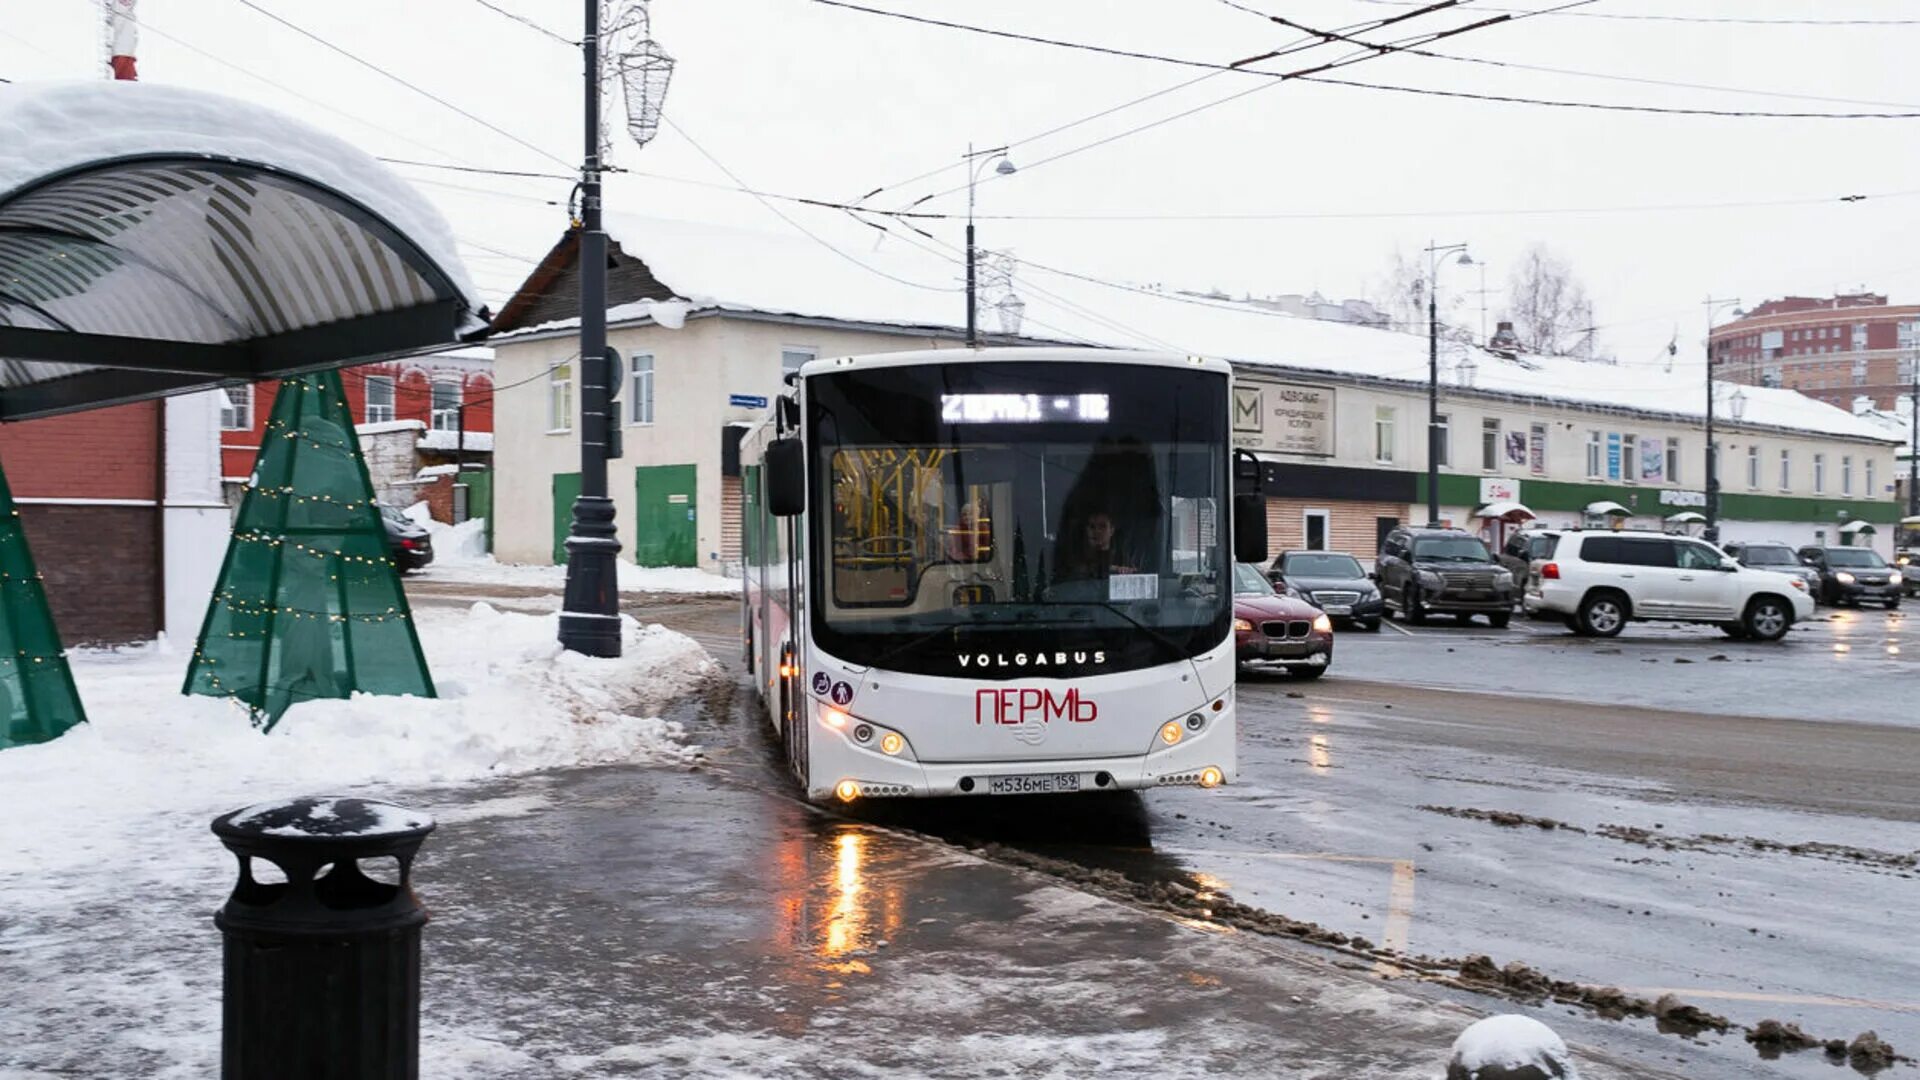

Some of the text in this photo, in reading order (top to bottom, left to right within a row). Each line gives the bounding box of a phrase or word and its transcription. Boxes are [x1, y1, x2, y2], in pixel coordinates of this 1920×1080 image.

[958, 651, 1105, 667] VOLGABUS
[976, 687, 1098, 725] ПЕРМЬ
[1055, 775, 1077, 786] 159
